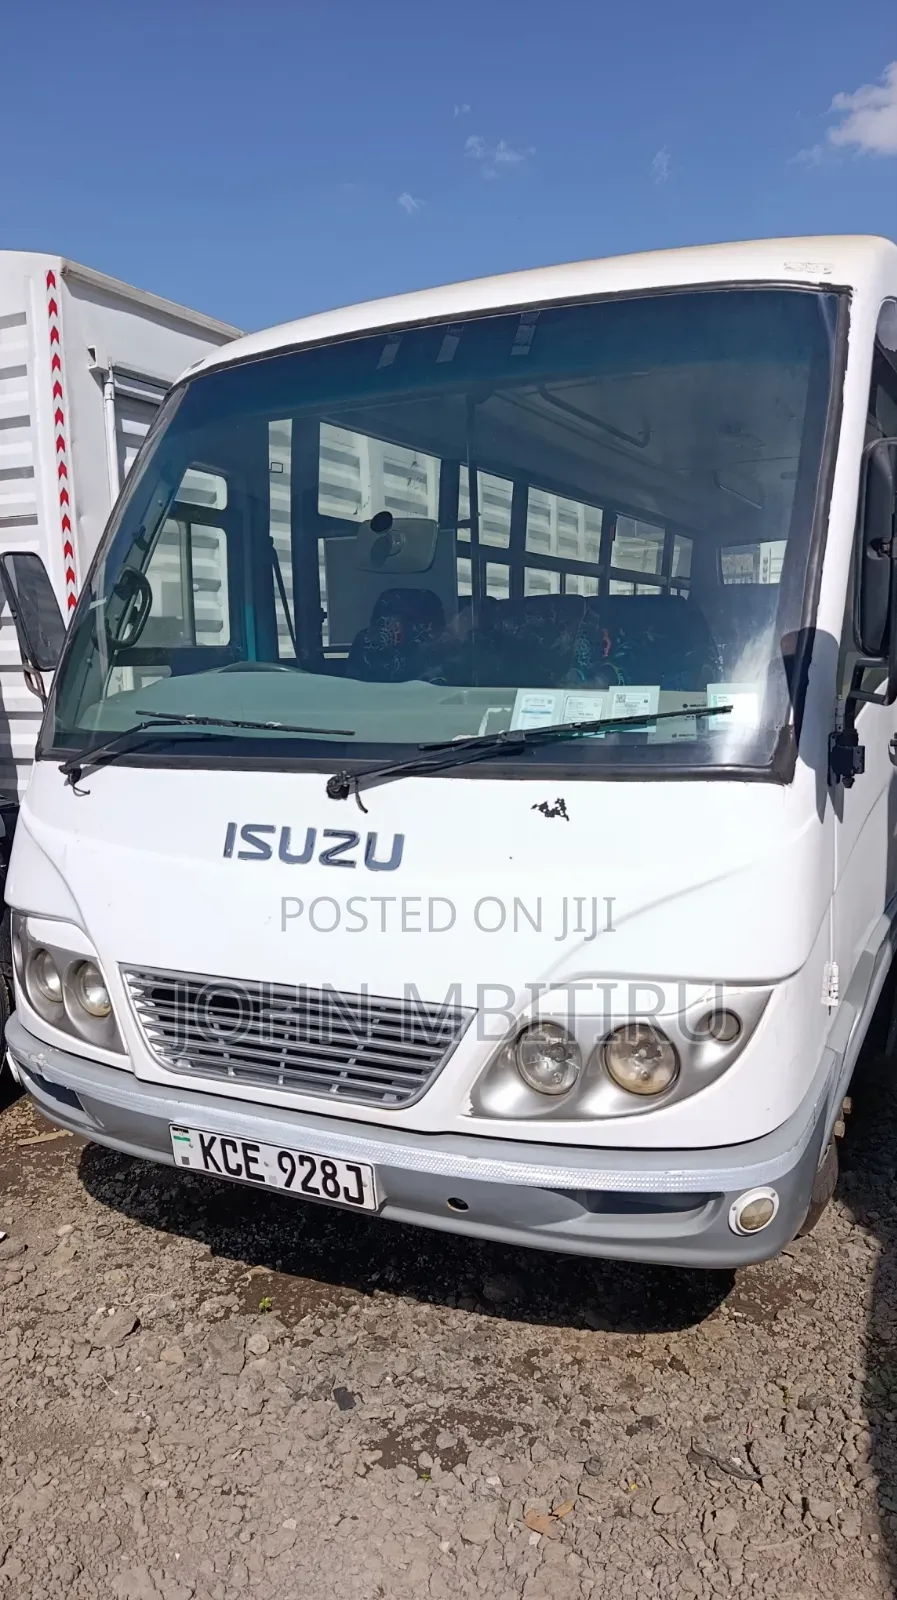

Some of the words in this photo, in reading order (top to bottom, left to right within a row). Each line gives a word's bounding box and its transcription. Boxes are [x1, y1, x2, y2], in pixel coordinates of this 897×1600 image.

[223, 821, 405, 871] ISUZU
[198, 1133, 266, 1182] KCE
[277, 1150, 365, 1205] 928J
